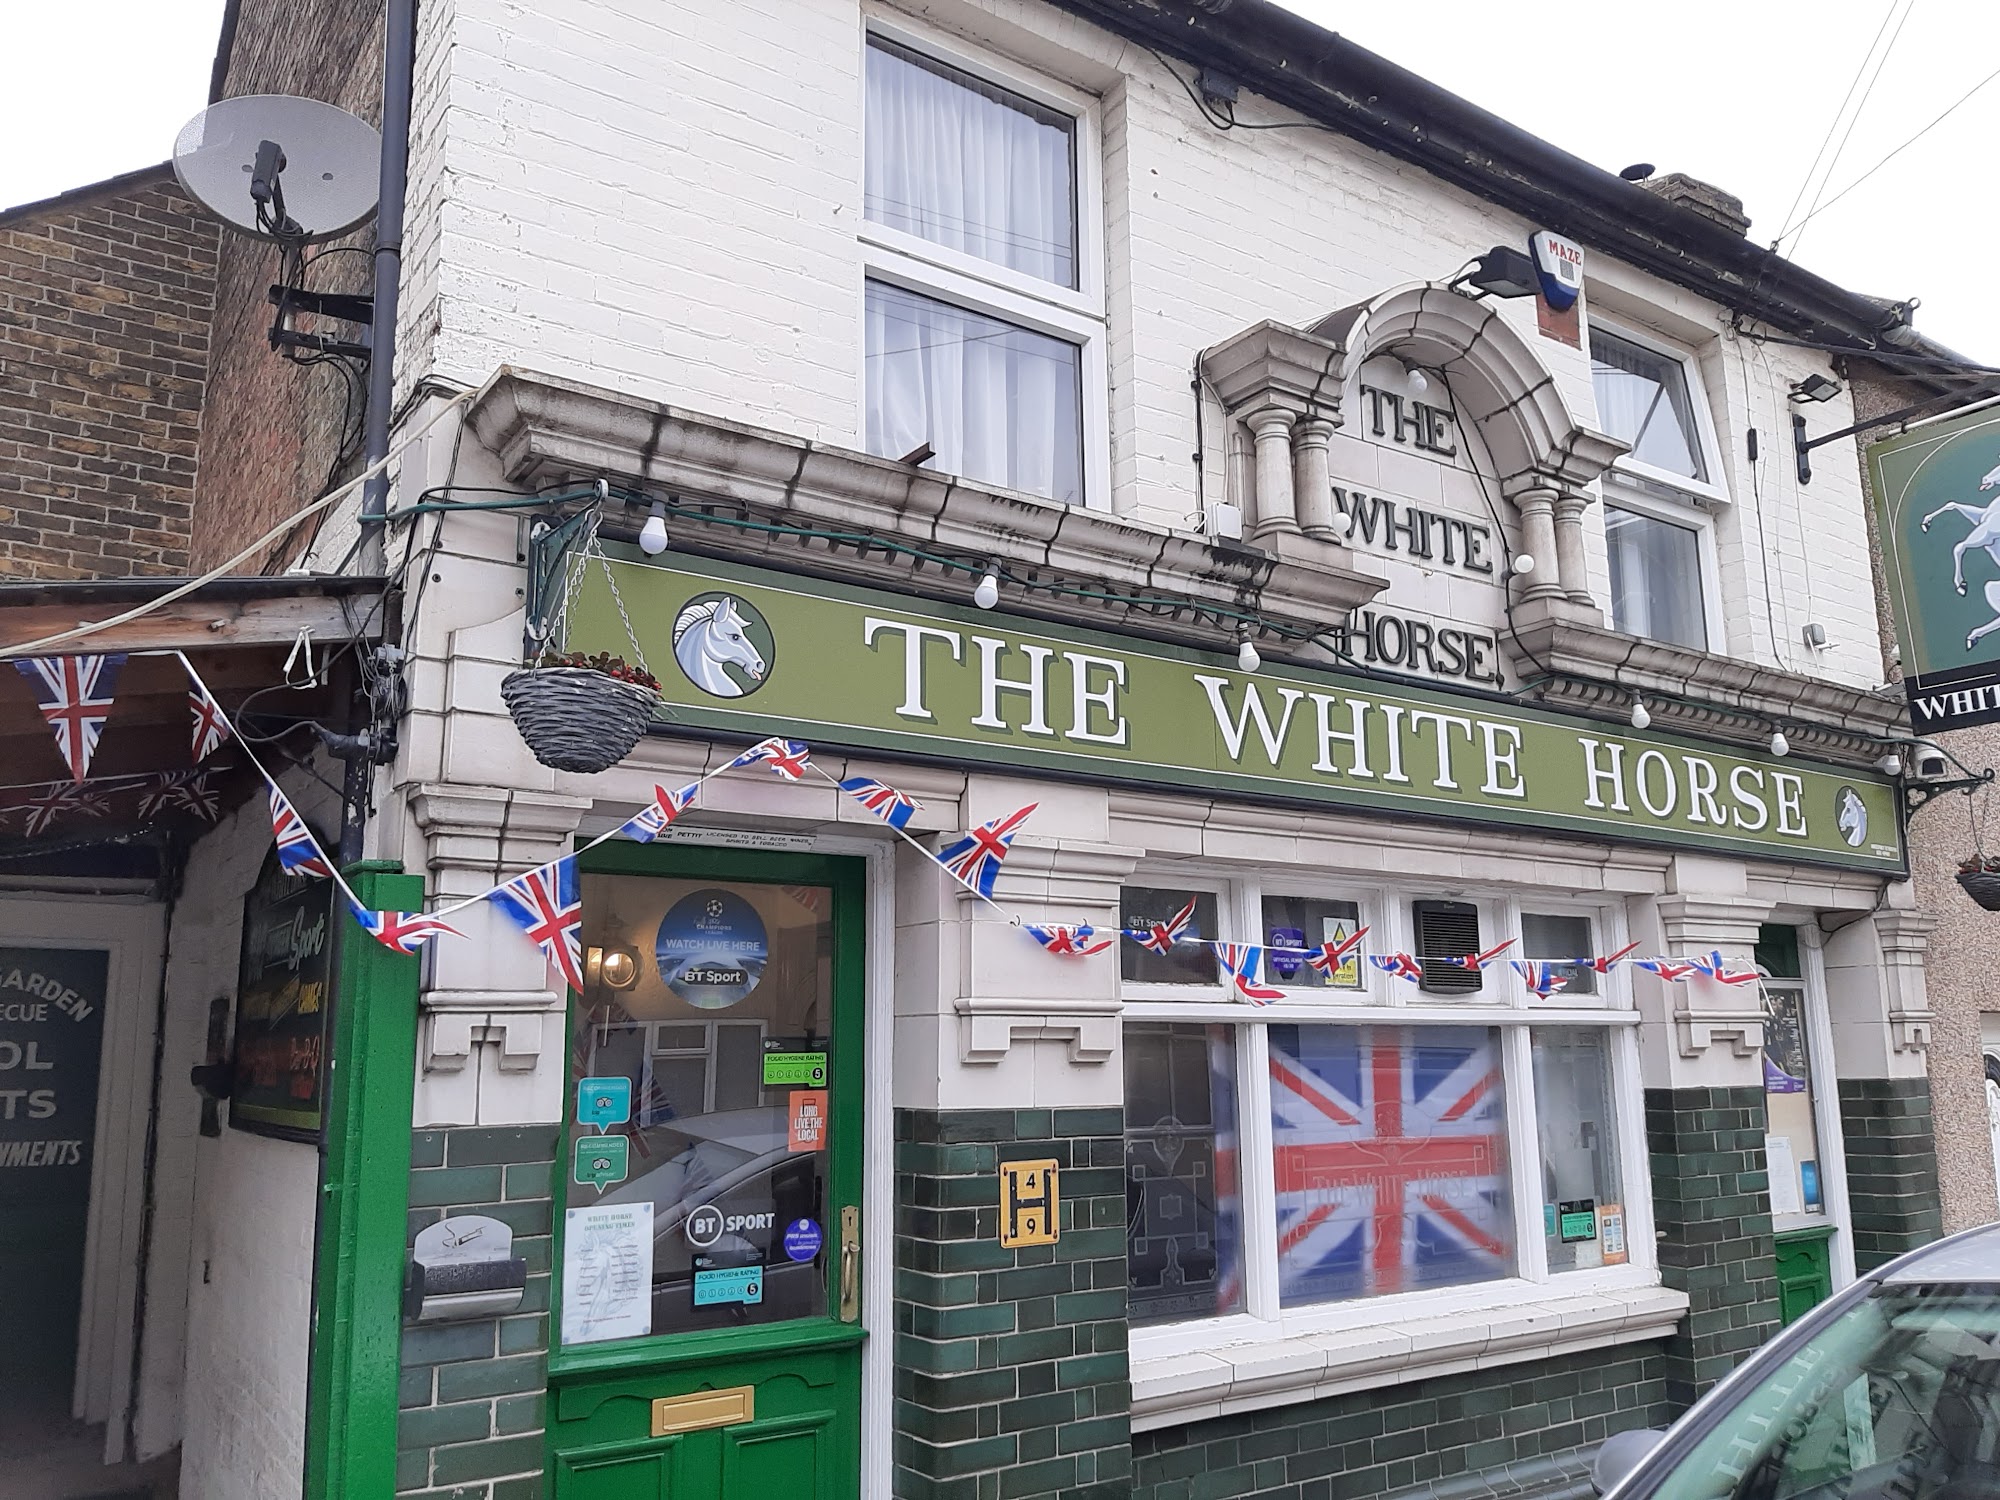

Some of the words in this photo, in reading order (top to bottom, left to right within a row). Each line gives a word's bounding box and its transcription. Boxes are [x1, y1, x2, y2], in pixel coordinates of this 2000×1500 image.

[1548, 239, 1581, 266] MAZE
[1360, 383, 1457, 457] THE
[1332, 486, 1493, 574] WHITE
[864, 616, 1129, 747] THE
[1194, 674, 1525, 799] WHITE
[1577, 737, 1809, 838] HORSE
[666, 939, 704, 950] WATCH
[708, 940, 730, 951] LIVE
[731, 941, 761, 951] HERE
[1286, 938, 1303, 948] SPORT
[684, 971, 705, 982] BT
[706, 970, 741, 984] Sport
[0, 968, 94, 1023] ARDEN
[799, 1104, 818, 1117] LONG
[794, 1117, 809, 1129] LIVE
[809, 1117, 823, 1128] THE
[797, 1128, 819, 1141] LOCAL
[1025, 1172, 1036, 1190] 4
[1009, 1168, 1052, 1238] H
[587, 1213, 610, 1223] WHITE
[611, 1212, 633, 1221] HORSE
[695, 1217, 716, 1234] BT
[726, 1212, 775, 1232] SPORT
[584, 1222, 614, 1232] OPENING
[616, 1221, 636, 1230] TIMES
[1026, 1217, 1036, 1235] 9
[698, 1272, 716, 1281] FOOD
